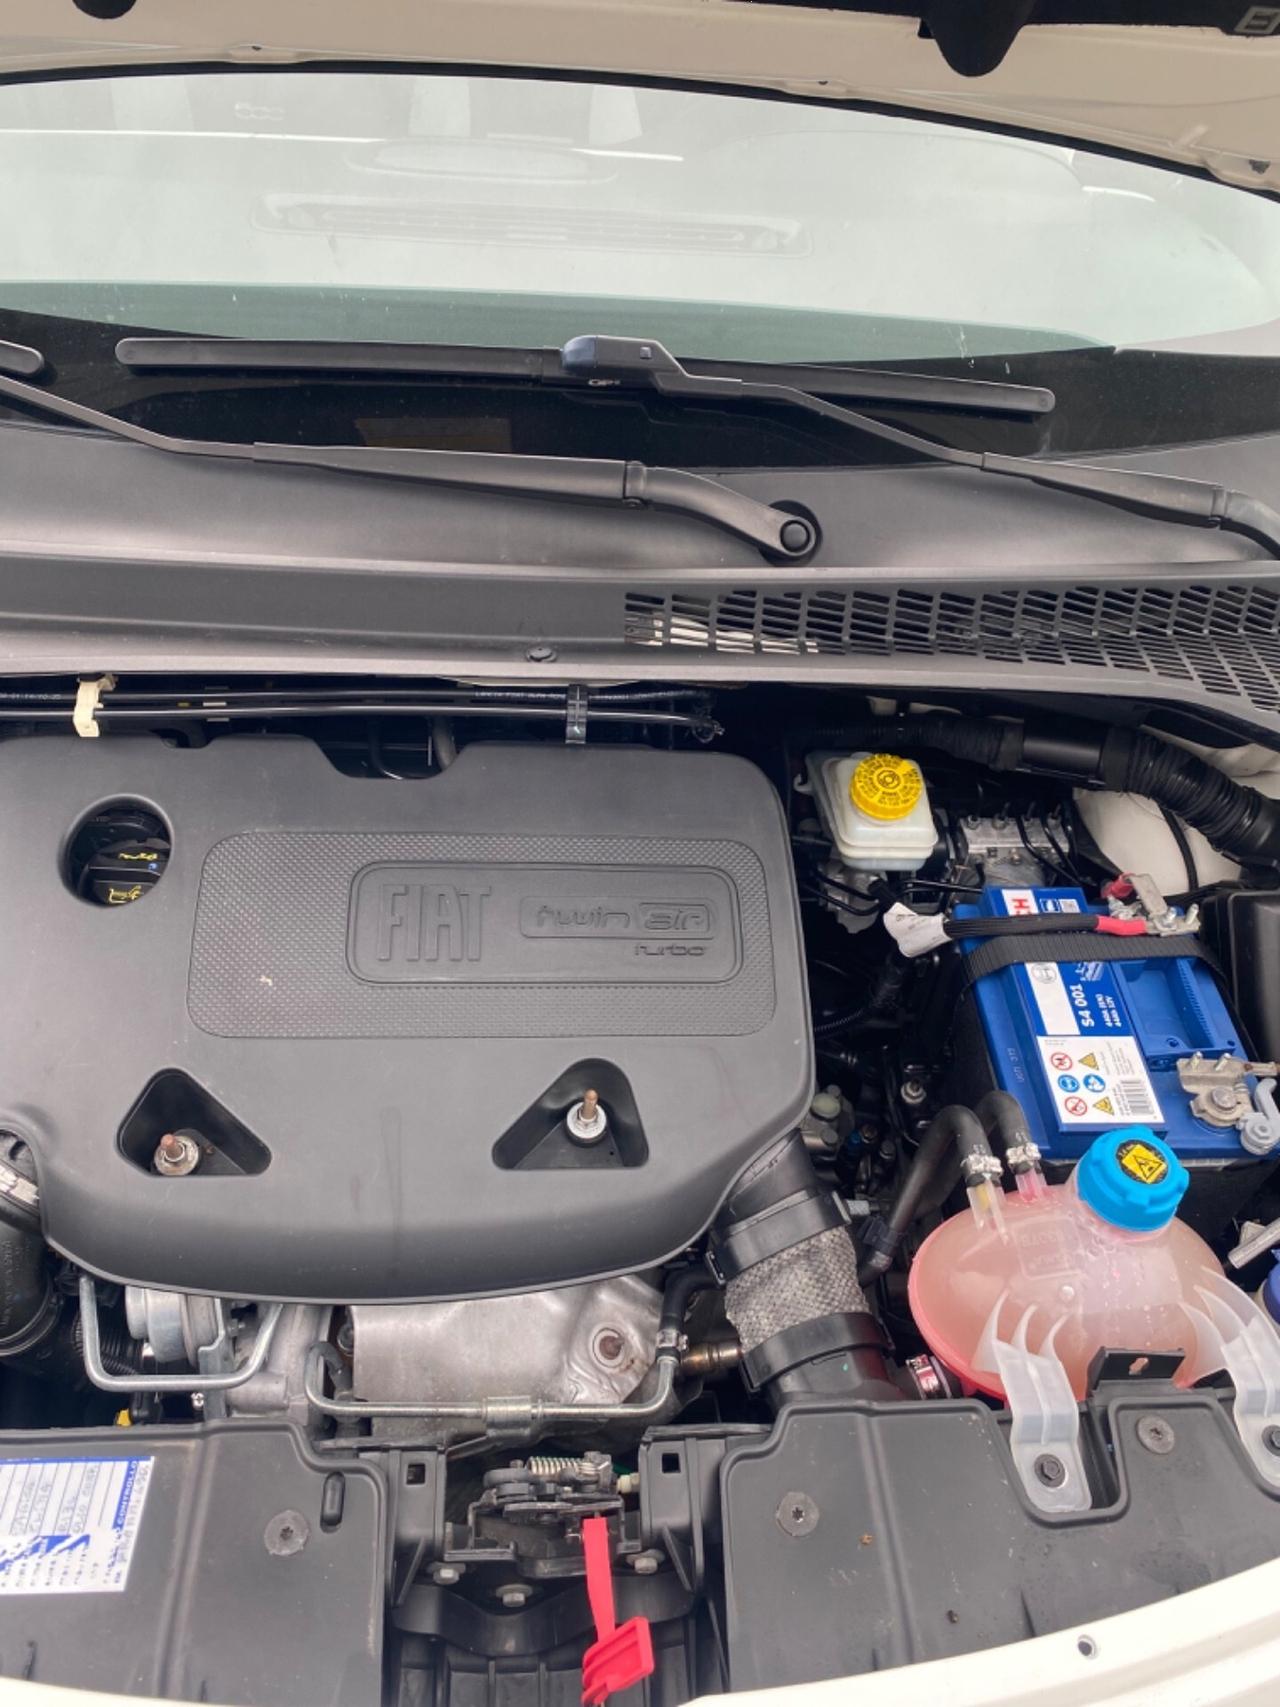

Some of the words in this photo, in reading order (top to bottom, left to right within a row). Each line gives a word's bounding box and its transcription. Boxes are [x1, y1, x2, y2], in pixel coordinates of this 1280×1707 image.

[378, 884, 491, 962] FIAT
[634, 943, 707, 957] turbo
[1070, 984, 1088, 1007] 001
[1078, 1010, 1095, 1027] S4
